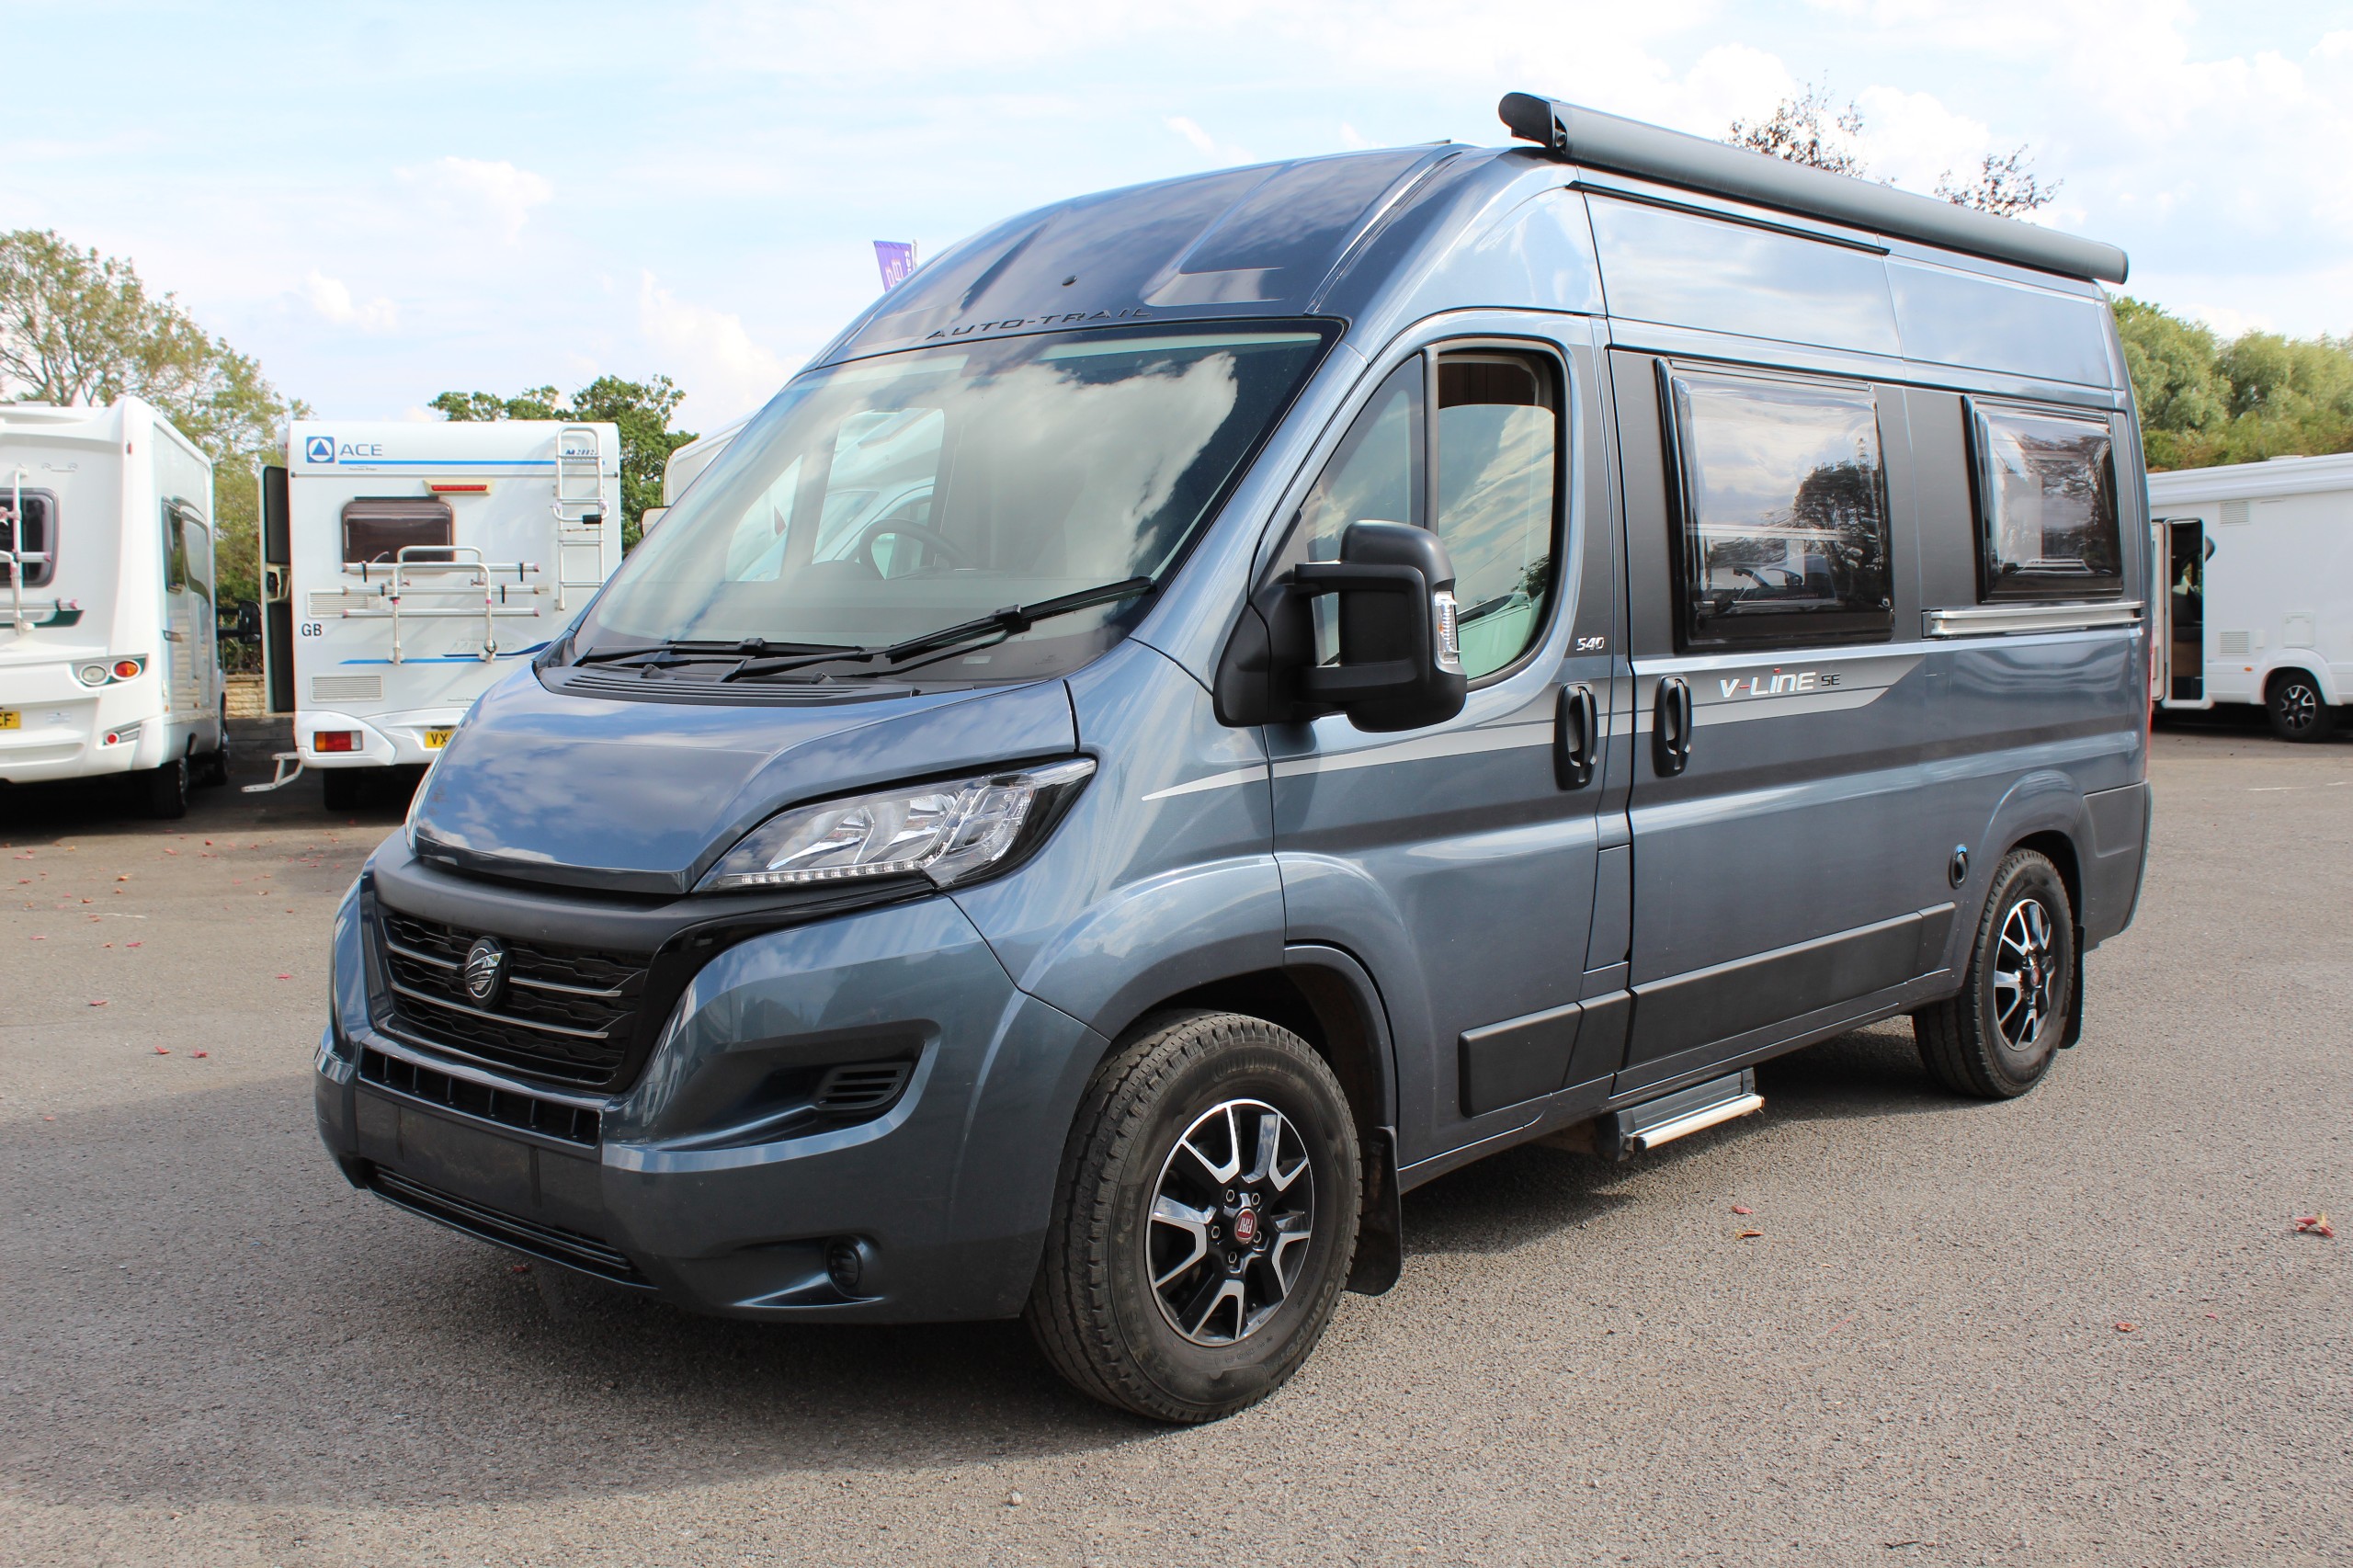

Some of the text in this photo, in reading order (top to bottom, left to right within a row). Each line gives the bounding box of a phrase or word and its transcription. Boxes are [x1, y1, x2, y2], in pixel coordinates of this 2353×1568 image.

[925, 308, 1153, 341] AUTO-TRAIL
[339, 443, 383, 457] ACE
[301, 623, 323, 637] GB
[1575, 636, 1605, 652] 540
[1821, 673, 1841, 687] SE
[1237, 1217, 1254, 1234] FIAT
